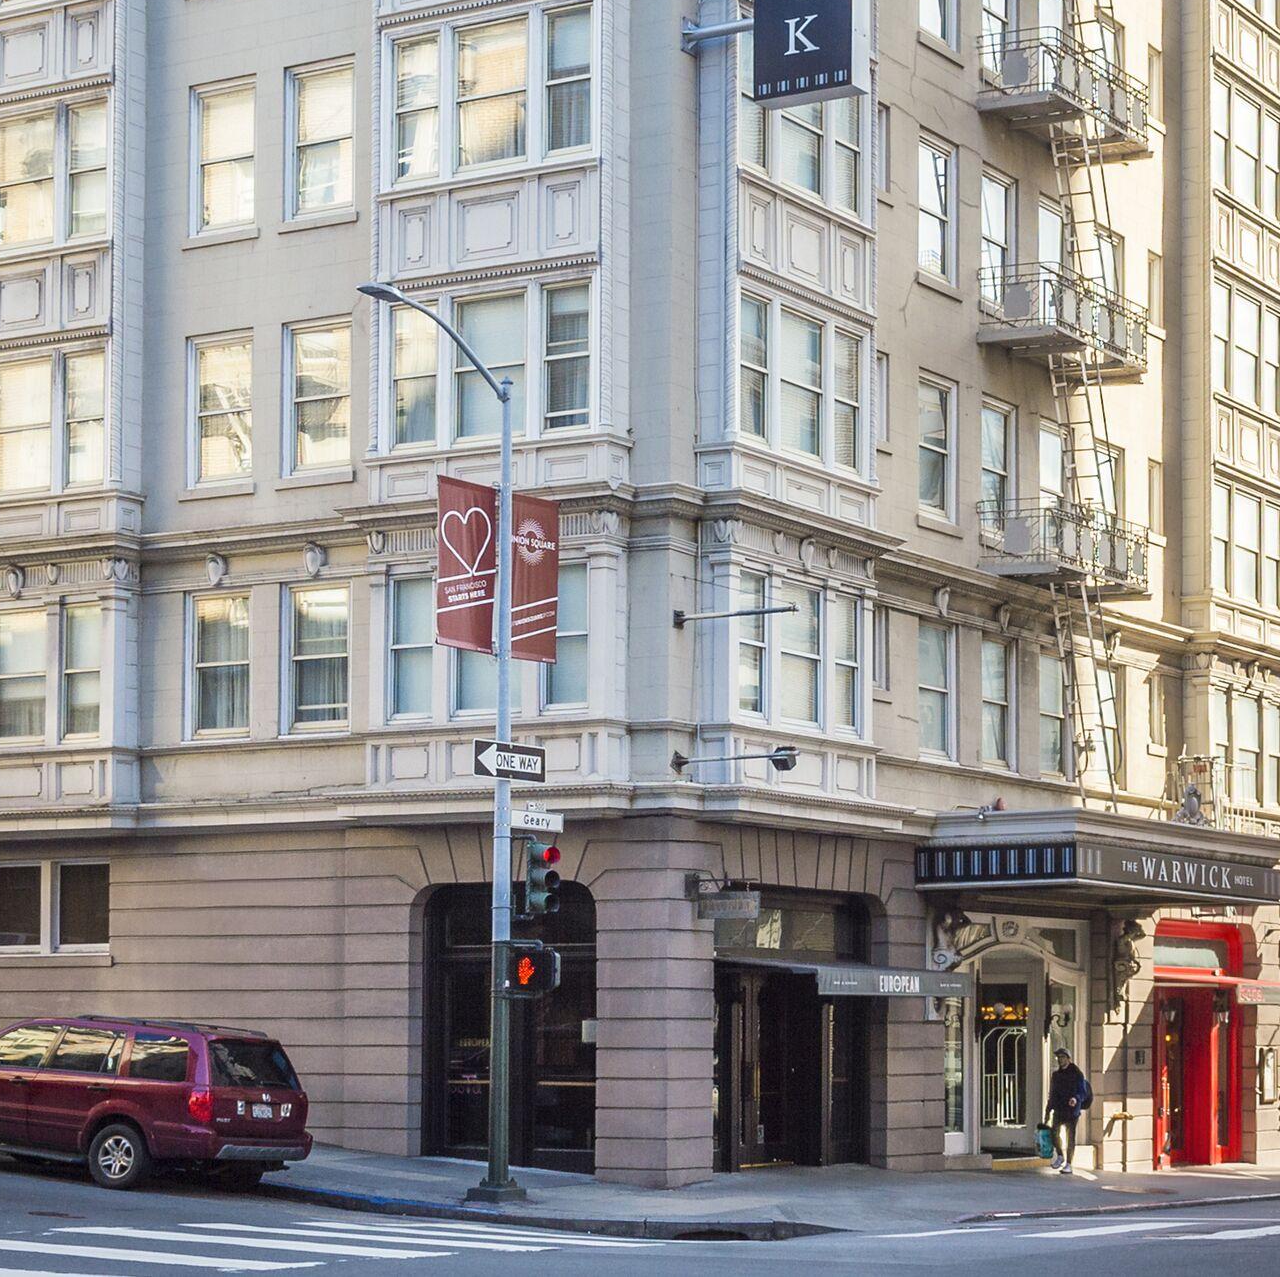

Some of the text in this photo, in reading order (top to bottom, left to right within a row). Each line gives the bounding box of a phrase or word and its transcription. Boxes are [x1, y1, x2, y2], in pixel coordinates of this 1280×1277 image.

[511, 535, 556, 551] NION SQUARE
[444, 579, 487, 595] SAN FRANCISCO
[448, 588, 486, 602] STARTS HERE
[496, 753, 538, 771] ONE WAY
[523, 814, 551, 829] Geary
[1122, 856, 1254, 889] THE WARWICK HOTEL
[879, 975, 920, 993] EUROPEAN
